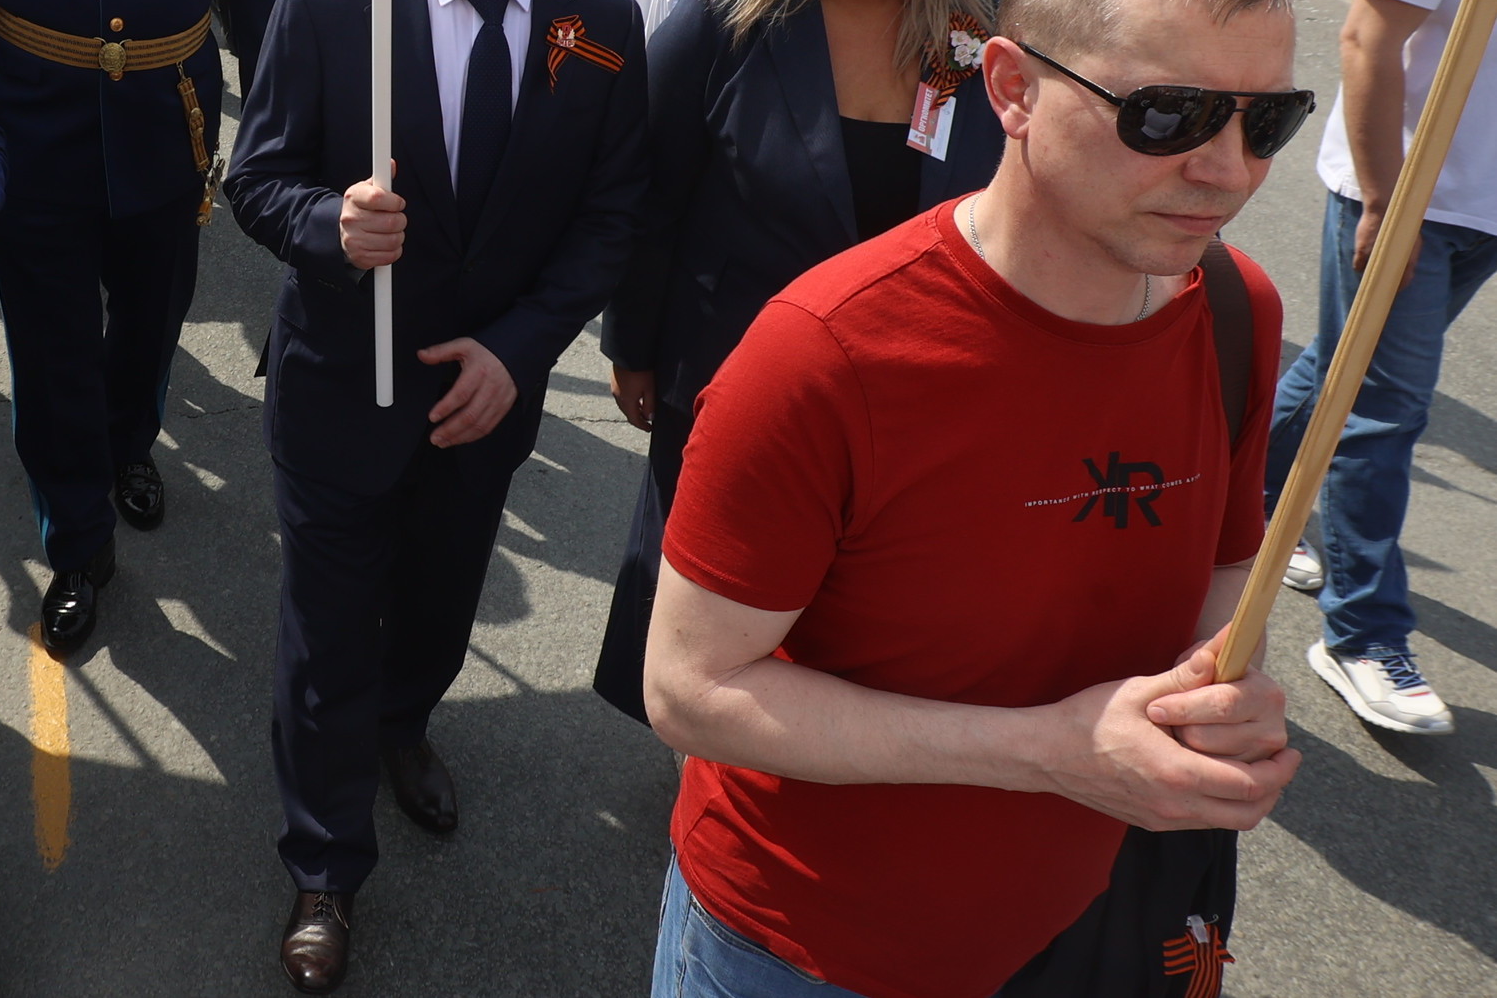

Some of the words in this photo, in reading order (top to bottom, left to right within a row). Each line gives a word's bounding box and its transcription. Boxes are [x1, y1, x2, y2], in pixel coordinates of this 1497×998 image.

[917, 88, 934, 133] ОРГКОМИТЕТ
[1073, 492, 1089, 500] WITH
[1091, 486, 1122, 496] RESPECT
[1140, 483, 1159, 491] WHAT
[1161, 479, 1183, 489] COMES
